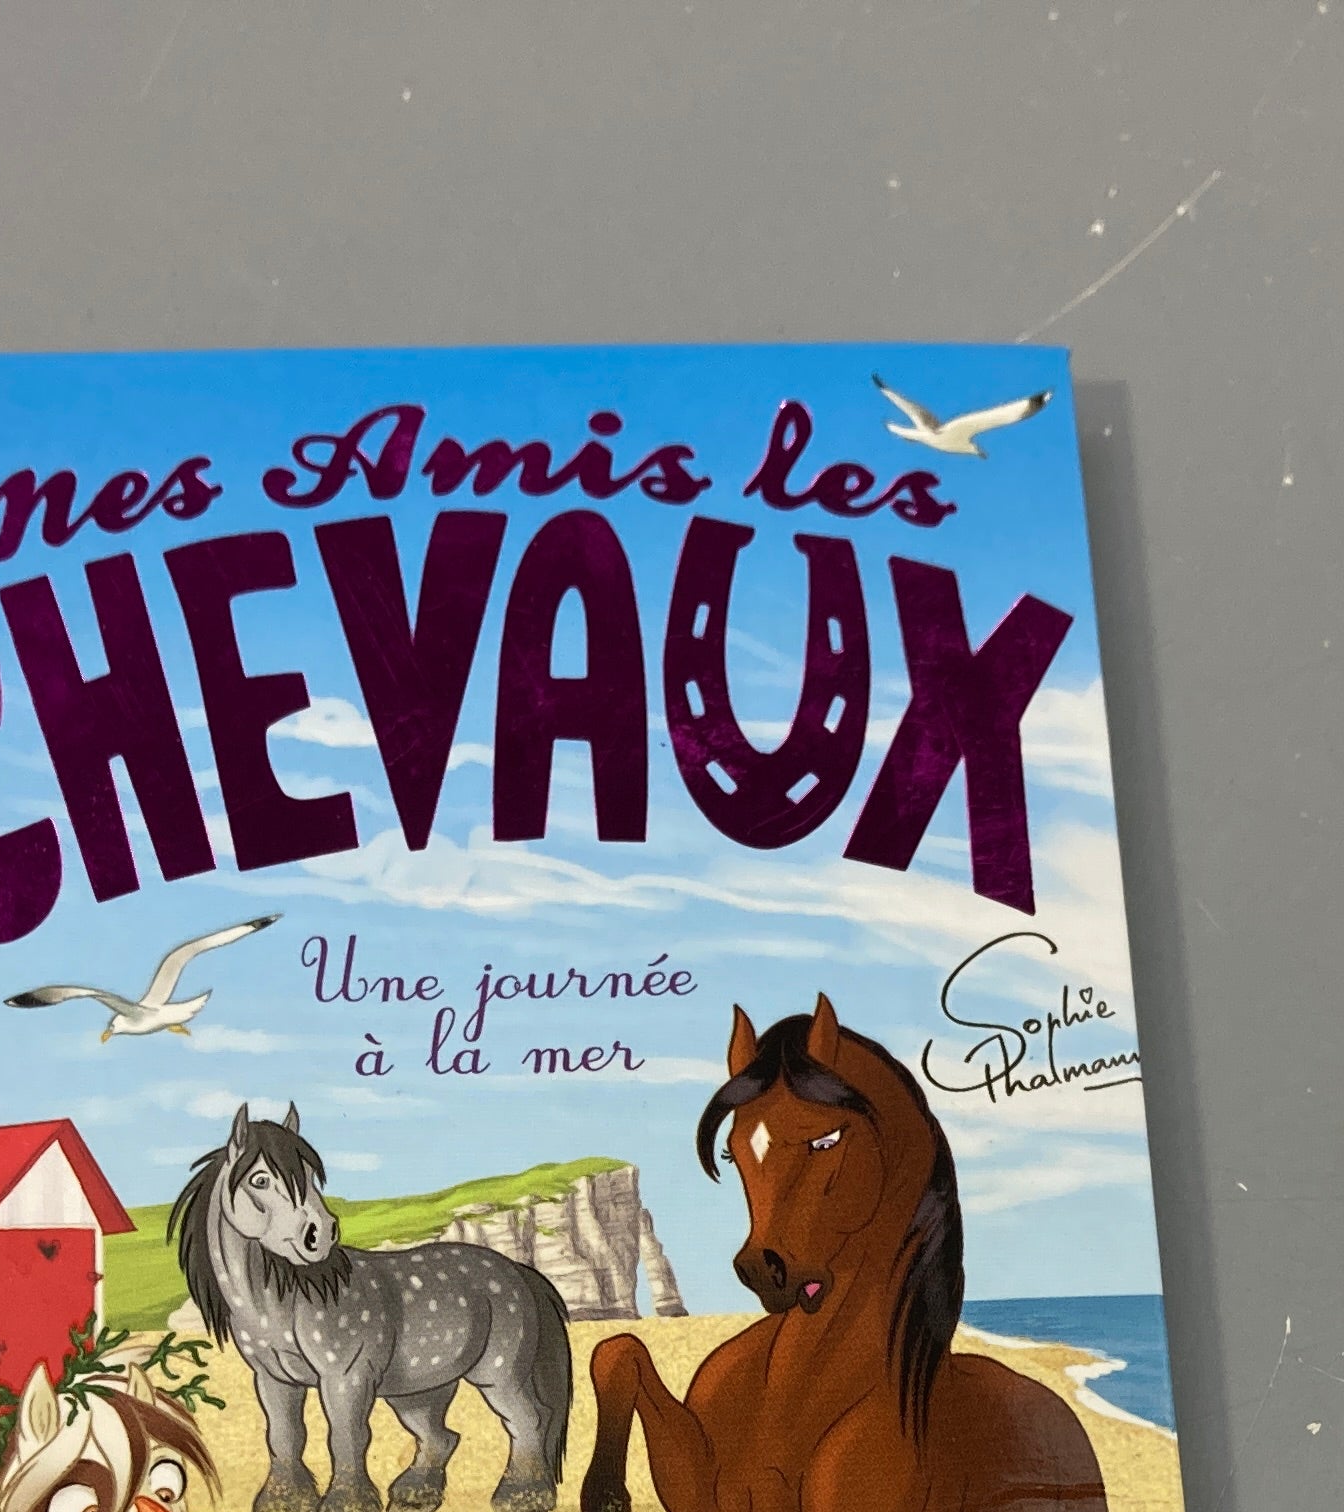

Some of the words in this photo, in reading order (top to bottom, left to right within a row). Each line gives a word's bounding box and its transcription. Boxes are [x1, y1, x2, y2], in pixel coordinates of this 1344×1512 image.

[261, 403, 711, 508] Amis
[743, 400, 957, 527] les
[301, 934, 445, 1003] Une
[463, 953, 698, 1043] journée
[355, 1032, 394, 1077] à
[425, 1007, 491, 1075] la
[521, 1040, 646, 1074] mer
[922, 931, 1116, 1092] Sophie
